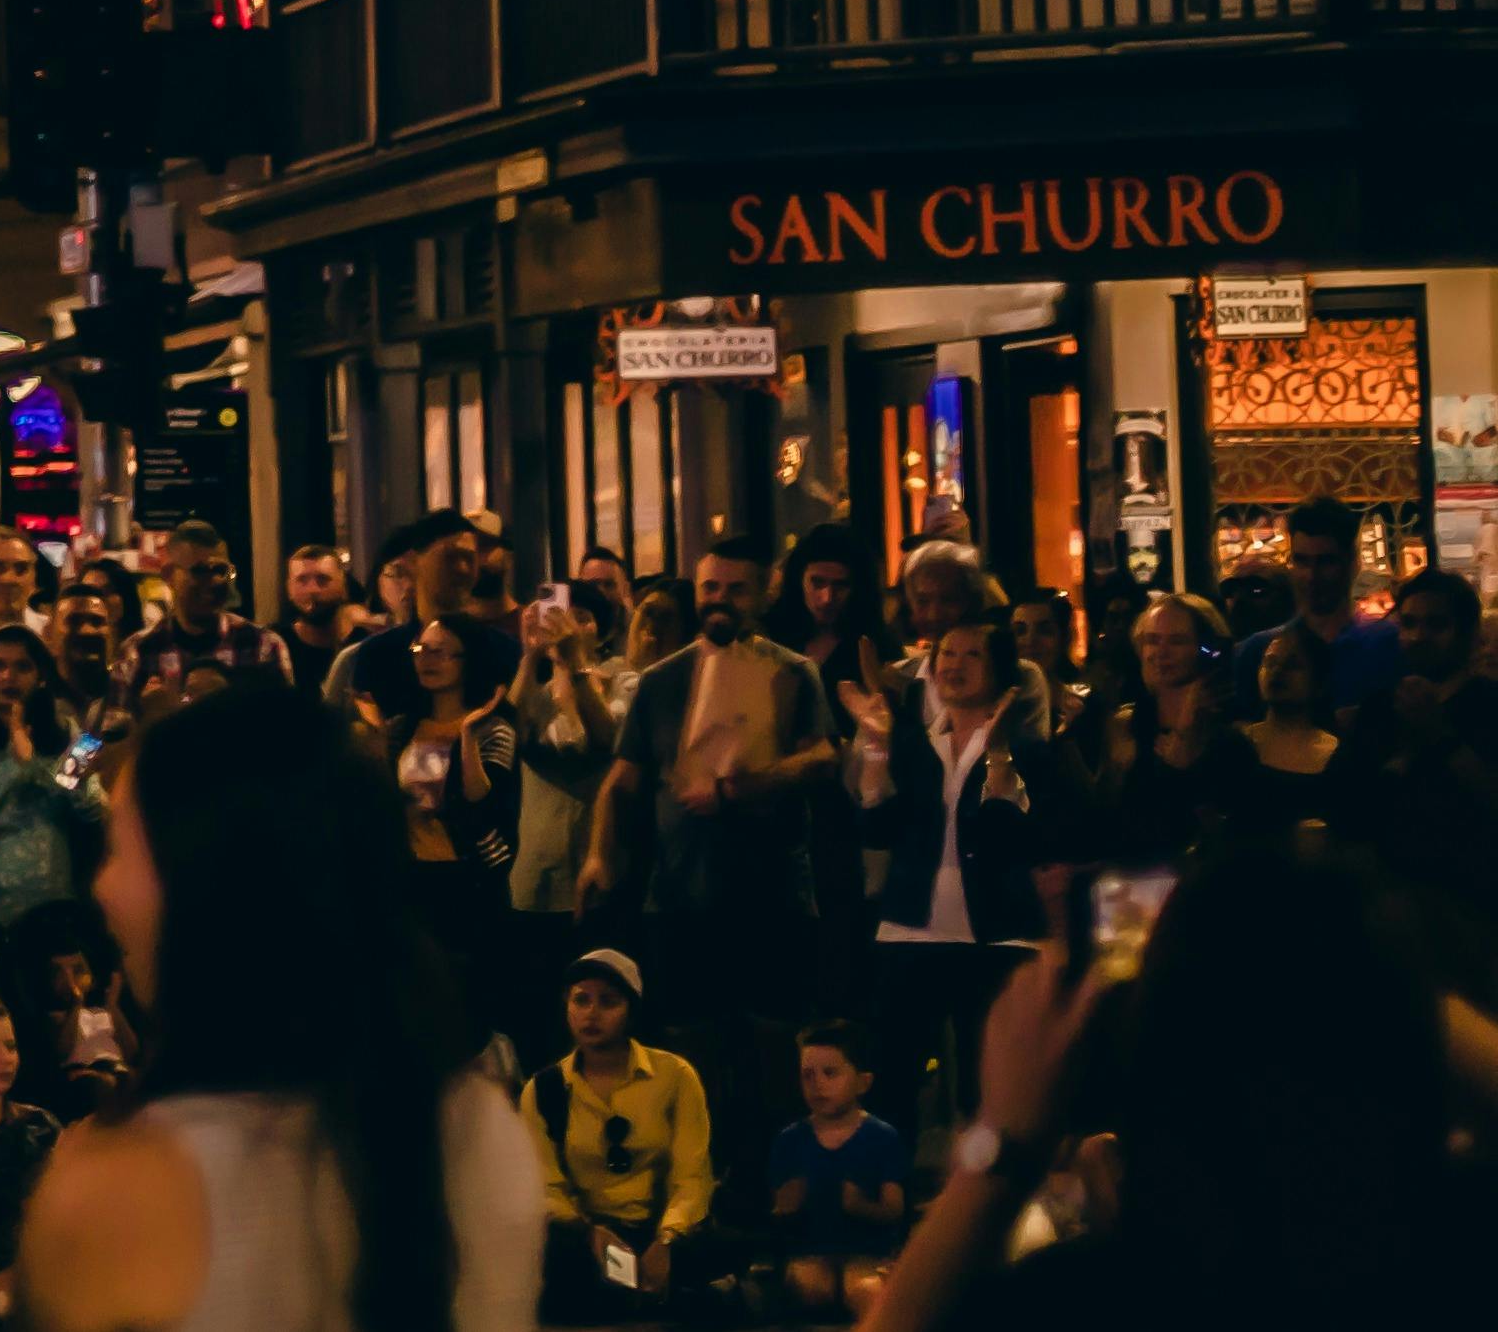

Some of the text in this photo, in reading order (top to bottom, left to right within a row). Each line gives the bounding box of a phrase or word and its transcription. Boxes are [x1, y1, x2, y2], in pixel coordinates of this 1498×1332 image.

[728, 170, 1284, 265] SAN CHURRO
[1217, 305, 1245, 324] SAN
[624, 351, 671, 369] SAN
